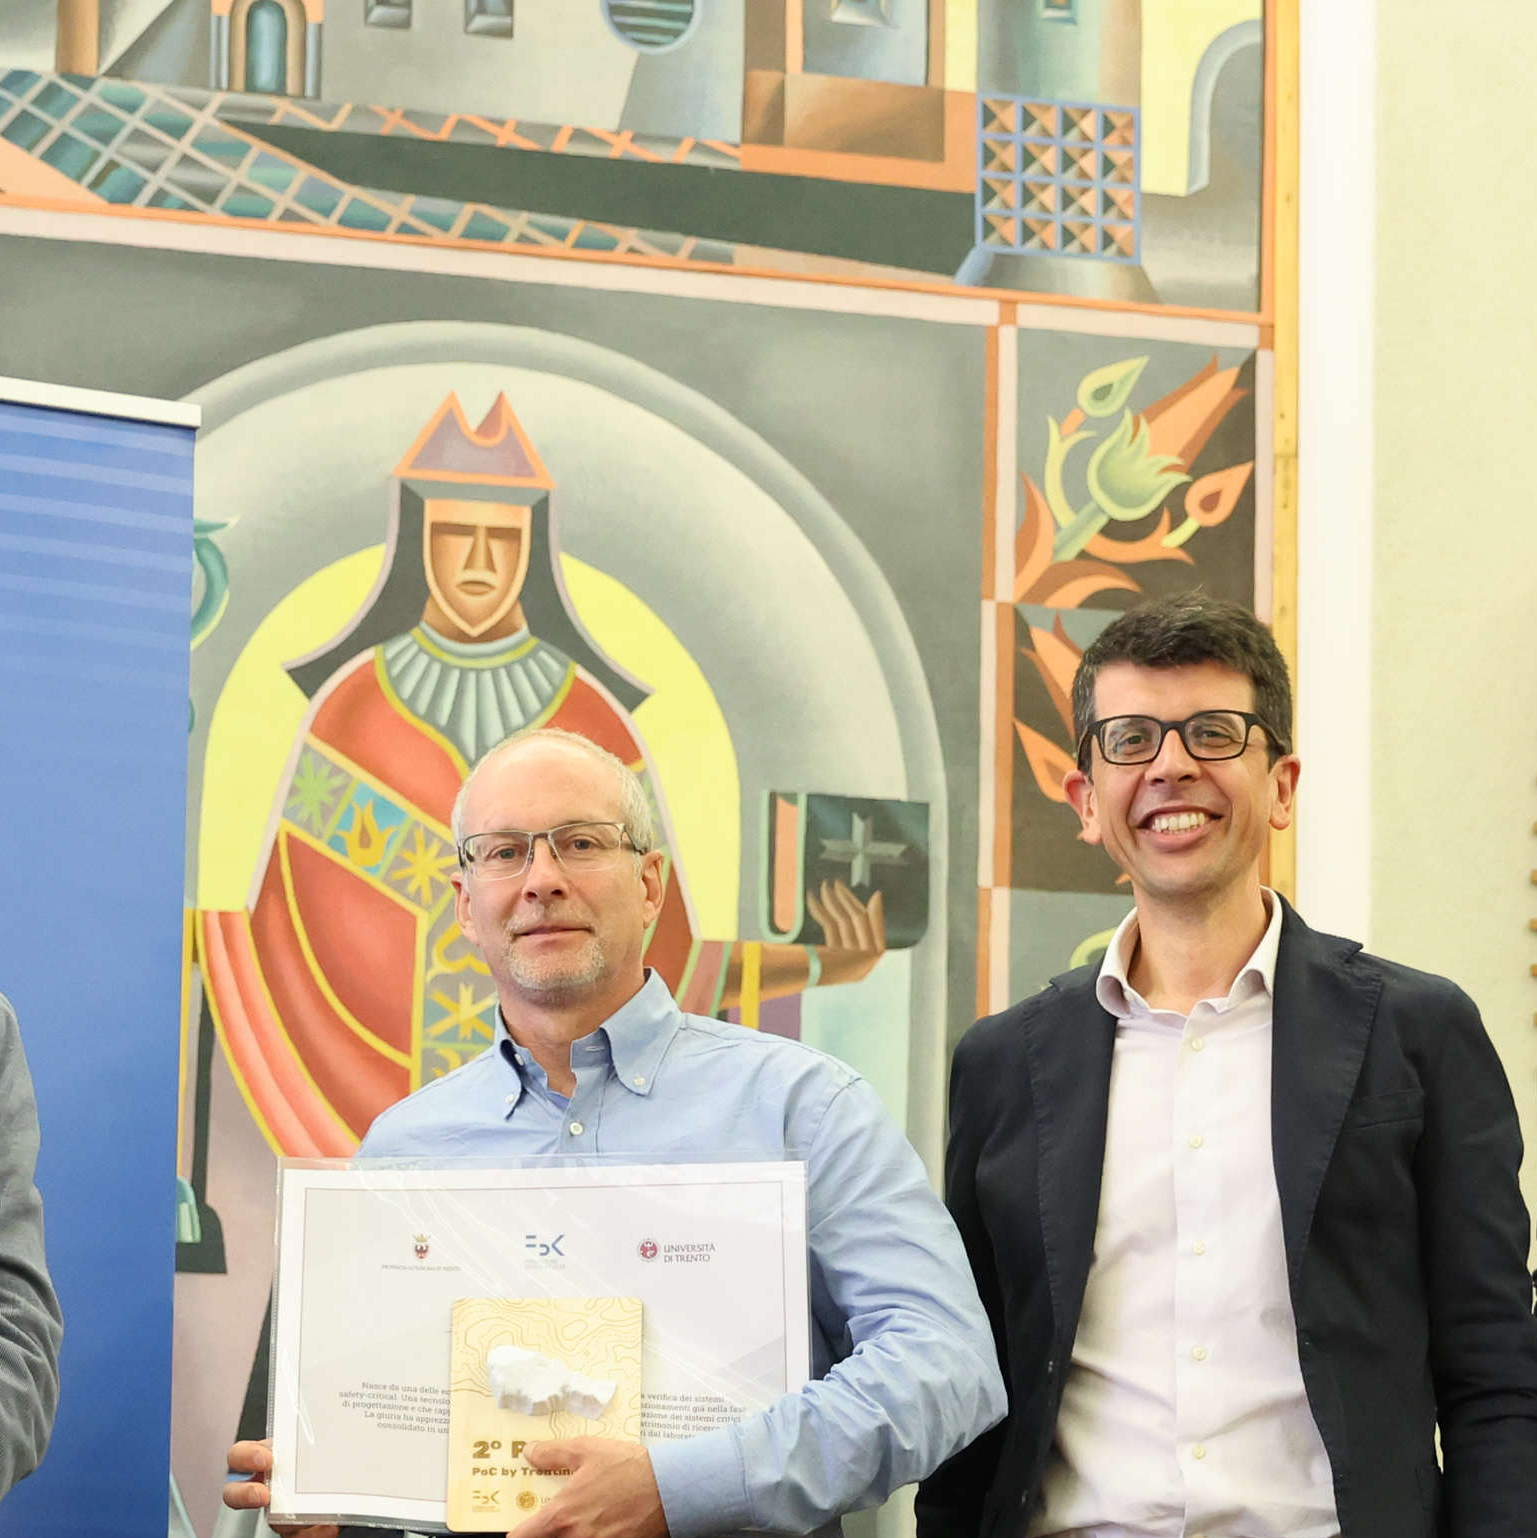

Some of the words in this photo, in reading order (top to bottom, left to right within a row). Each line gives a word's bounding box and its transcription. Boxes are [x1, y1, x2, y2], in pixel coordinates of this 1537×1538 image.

[664, 1254, 673, 1263] DI
[675, 1253, 710, 1262] TRENTO
[419, 1386, 439, 1395] delle
[472, 1467, 497, 1476] PoC
[502, 1467, 517, 1478] by
[521, 1467, 574, 1476] Trentin
